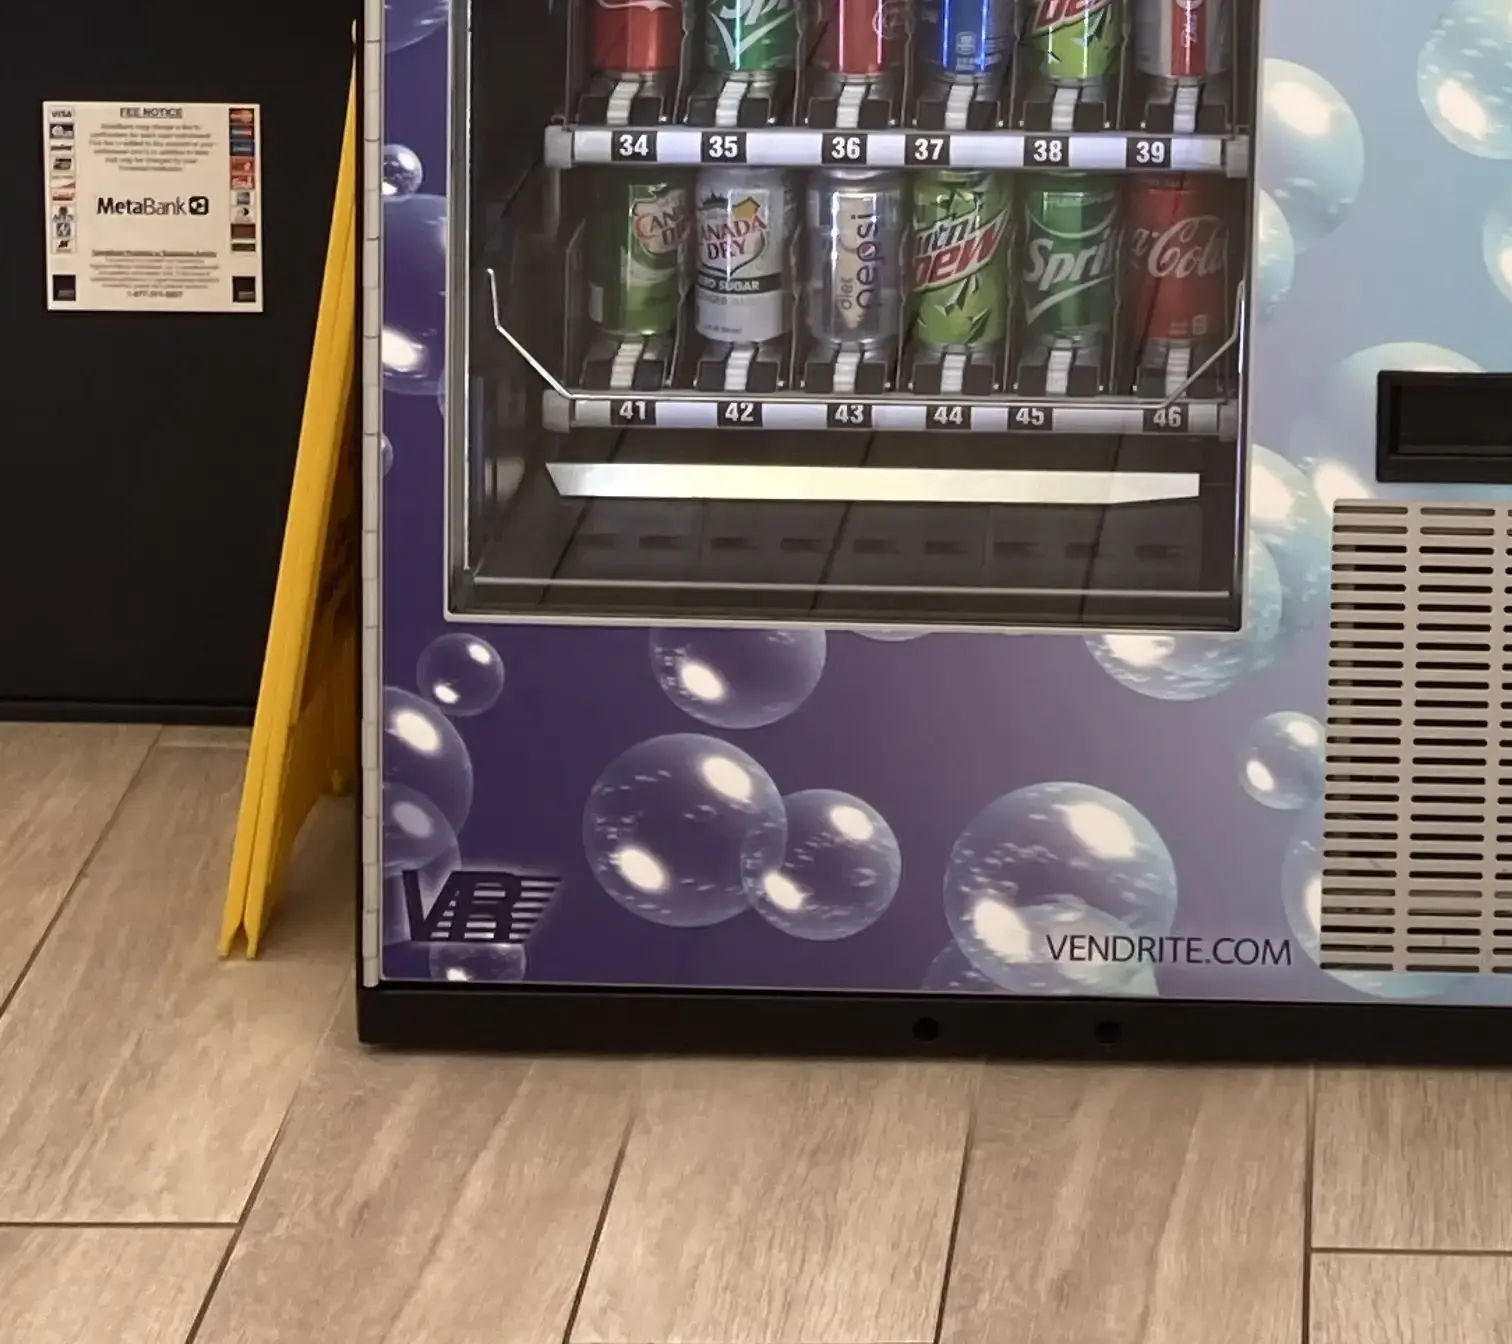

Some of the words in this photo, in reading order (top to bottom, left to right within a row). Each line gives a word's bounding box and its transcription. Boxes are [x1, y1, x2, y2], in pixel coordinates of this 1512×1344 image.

[619, 135, 650, 158] 34
[708, 135, 739, 158] 35
[830, 137, 861, 160] 36
[914, 138, 943, 161] 37
[1033, 140, 1063, 163] 38
[1136, 141, 1165, 164] 39
[97, 196, 186, 216] MetaBank
[708, 238, 748, 260] DRY
[857, 214, 884, 310] pepsi
[718, 279, 760, 292] SUGAR
[840, 276, 853, 310] diet
[619, 399, 648, 421] 41
[725, 400, 755, 423] 42
[834, 402, 865, 425] 43
[934, 404, 964, 427] 44
[1016, 405, 1045, 427] 45
[1153, 407, 1182, 430] 46
[1046, 933, 1292, 967] VENDRITE.COM
